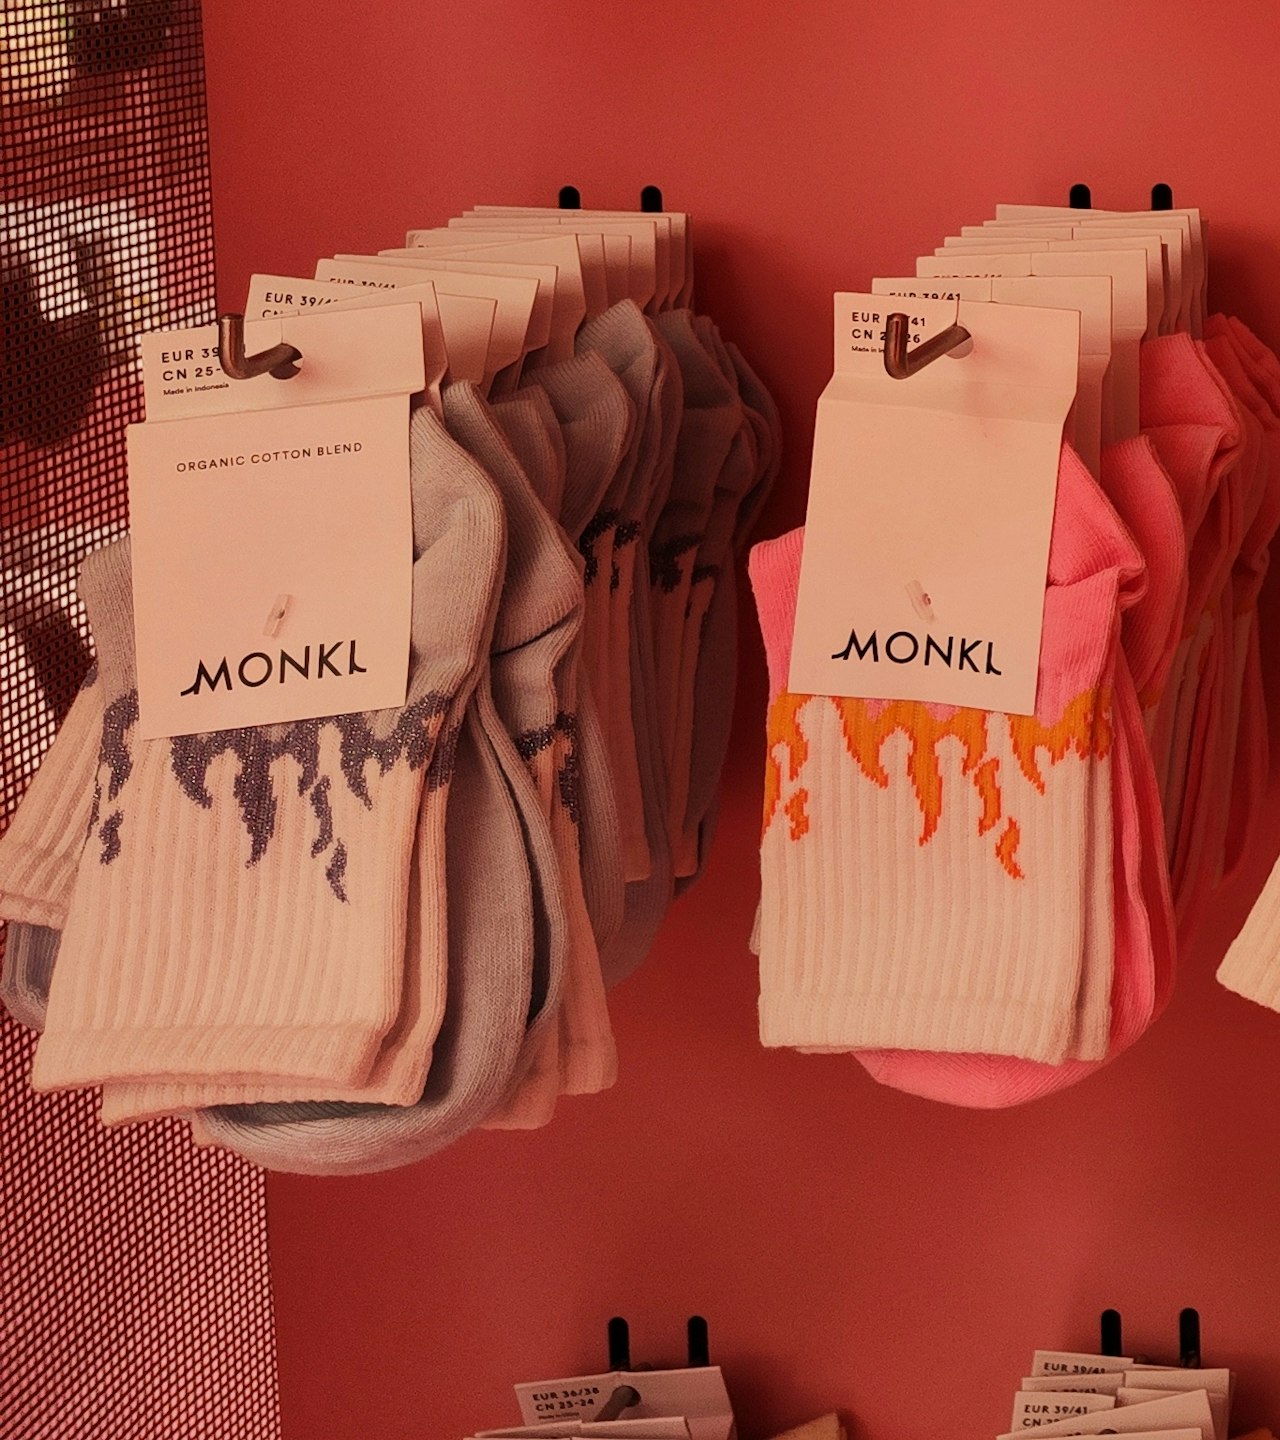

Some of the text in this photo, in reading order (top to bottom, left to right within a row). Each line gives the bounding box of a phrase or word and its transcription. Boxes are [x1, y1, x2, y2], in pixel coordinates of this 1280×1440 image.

[265, 292, 294, 306] EUR
[852, 312, 880, 323] EUR
[852, 329, 872, 339] CN
[162, 350, 194, 363] EUR
[163, 370, 188, 382] CN
[176, 441, 364, 473] ORGANIC COTTON BLEND
[1044, 1362, 1069, 1372] EUR
[532, 1390, 559, 1401] EUR
[1024, 1404, 1088, 1414] EUR 39/41
[1023, 1418, 1042, 1427] CN
